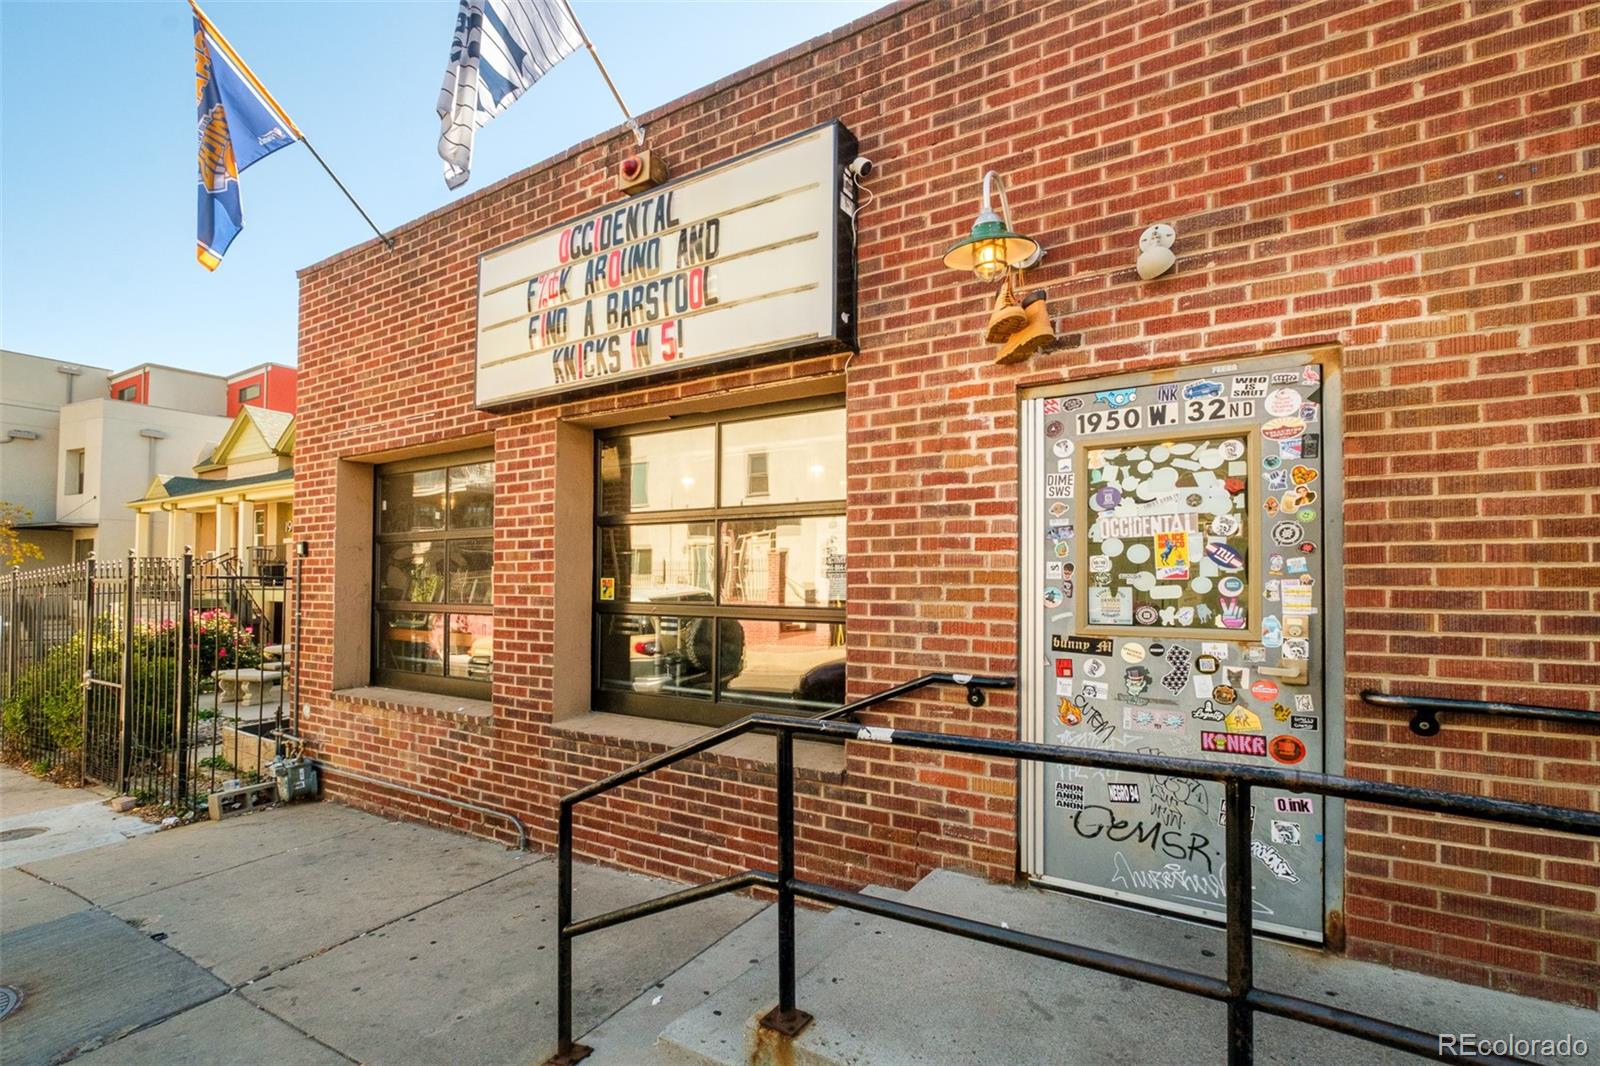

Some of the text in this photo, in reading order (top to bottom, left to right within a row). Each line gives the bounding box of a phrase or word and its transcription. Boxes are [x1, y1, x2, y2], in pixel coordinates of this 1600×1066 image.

[558, 191, 680, 263] OCCIDENTAL
[584, 236, 661, 296] AROUND
[676, 218, 720, 269] AND
[528, 266, 719, 350] FIND A BARSTOOL
[552, 319, 684, 384] KNICKS IN 5!
[1158, 389, 1178, 401] INK
[1077, 408, 1140, 434] 1950
[1149, 404, 1176, 426] W.
[1047, 474, 1074, 487] DIME
[1048, 486, 1071, 497] SWS
[1100, 512, 1198, 538] OCCIDENTAL
[1053, 637, 1090, 652] bunny
[1056, 782, 1084, 791] ANON
[1109, 784, 1140, 802] NEGRO 94
[1056, 791, 1084, 800] ANON
[1056, 800, 1084, 809] ANON
